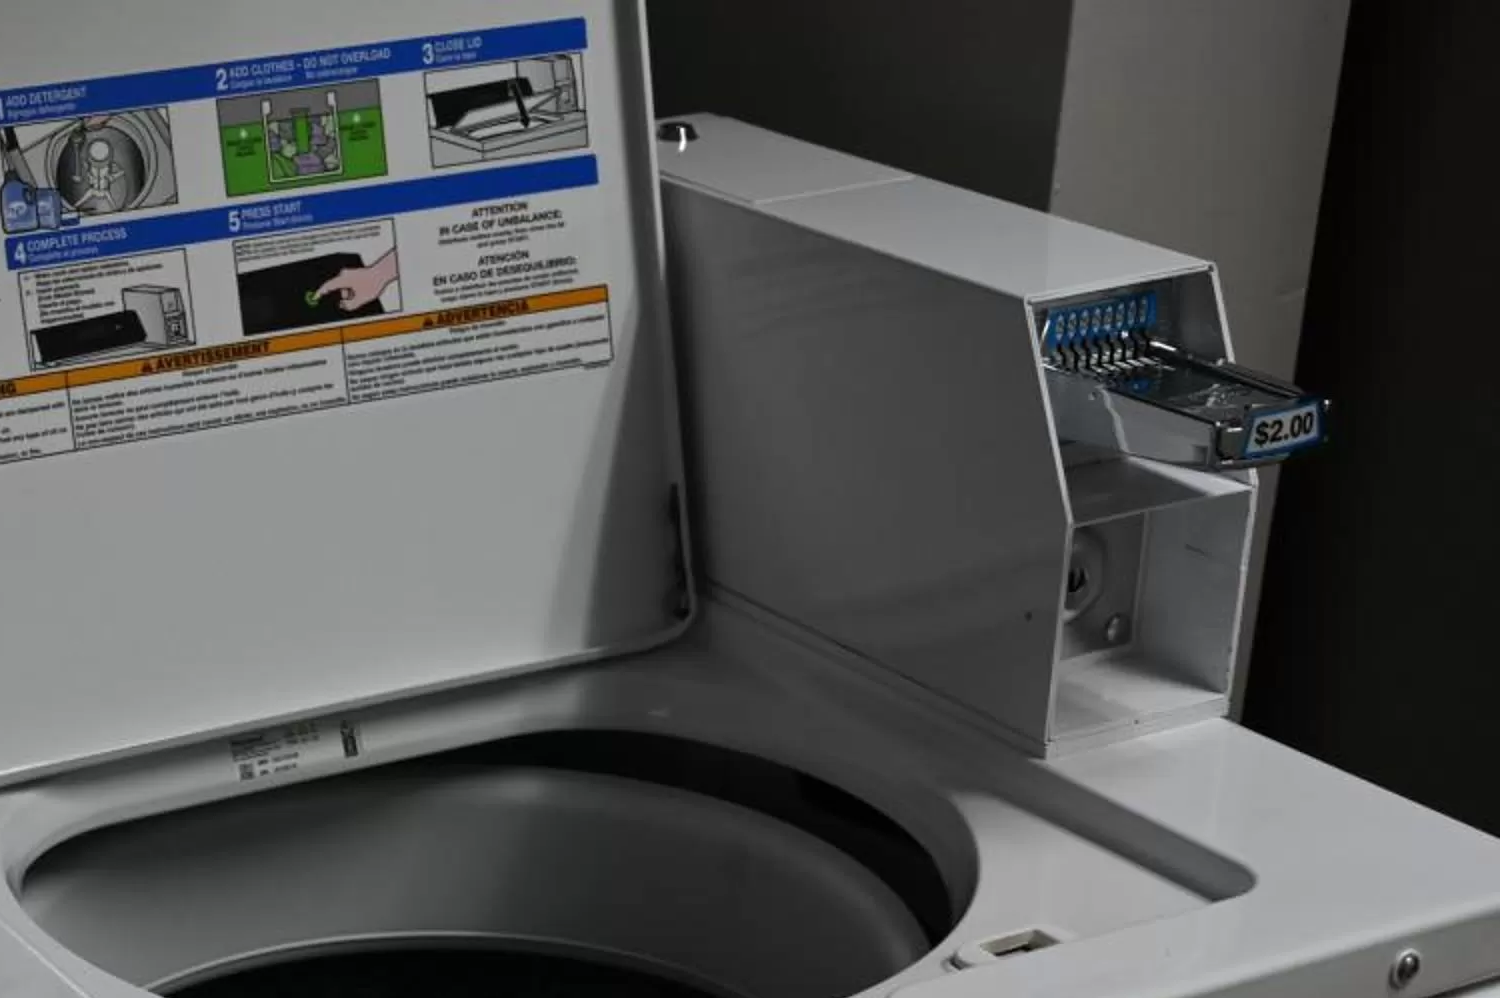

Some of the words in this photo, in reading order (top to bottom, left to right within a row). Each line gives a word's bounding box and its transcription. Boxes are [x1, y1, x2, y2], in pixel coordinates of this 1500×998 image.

[421, 43, 435, 65] 3
[215, 67, 229, 91] 2
[228, 210, 241, 233] 5
[471, 201, 529, 218] ATTENTION
[14, 241, 27, 265] 4
[27, 232, 80, 252] COMPLETE
[81, 226, 128, 244] PROCESS
[432, 274, 447, 287] EN
[479, 267, 493, 279] DE
[436, 299, 529, 325] ADVERTENCIA
[156, 341, 271, 370] AVERTISSEMENT
[1252, 411, 1314, 447] $2.00
